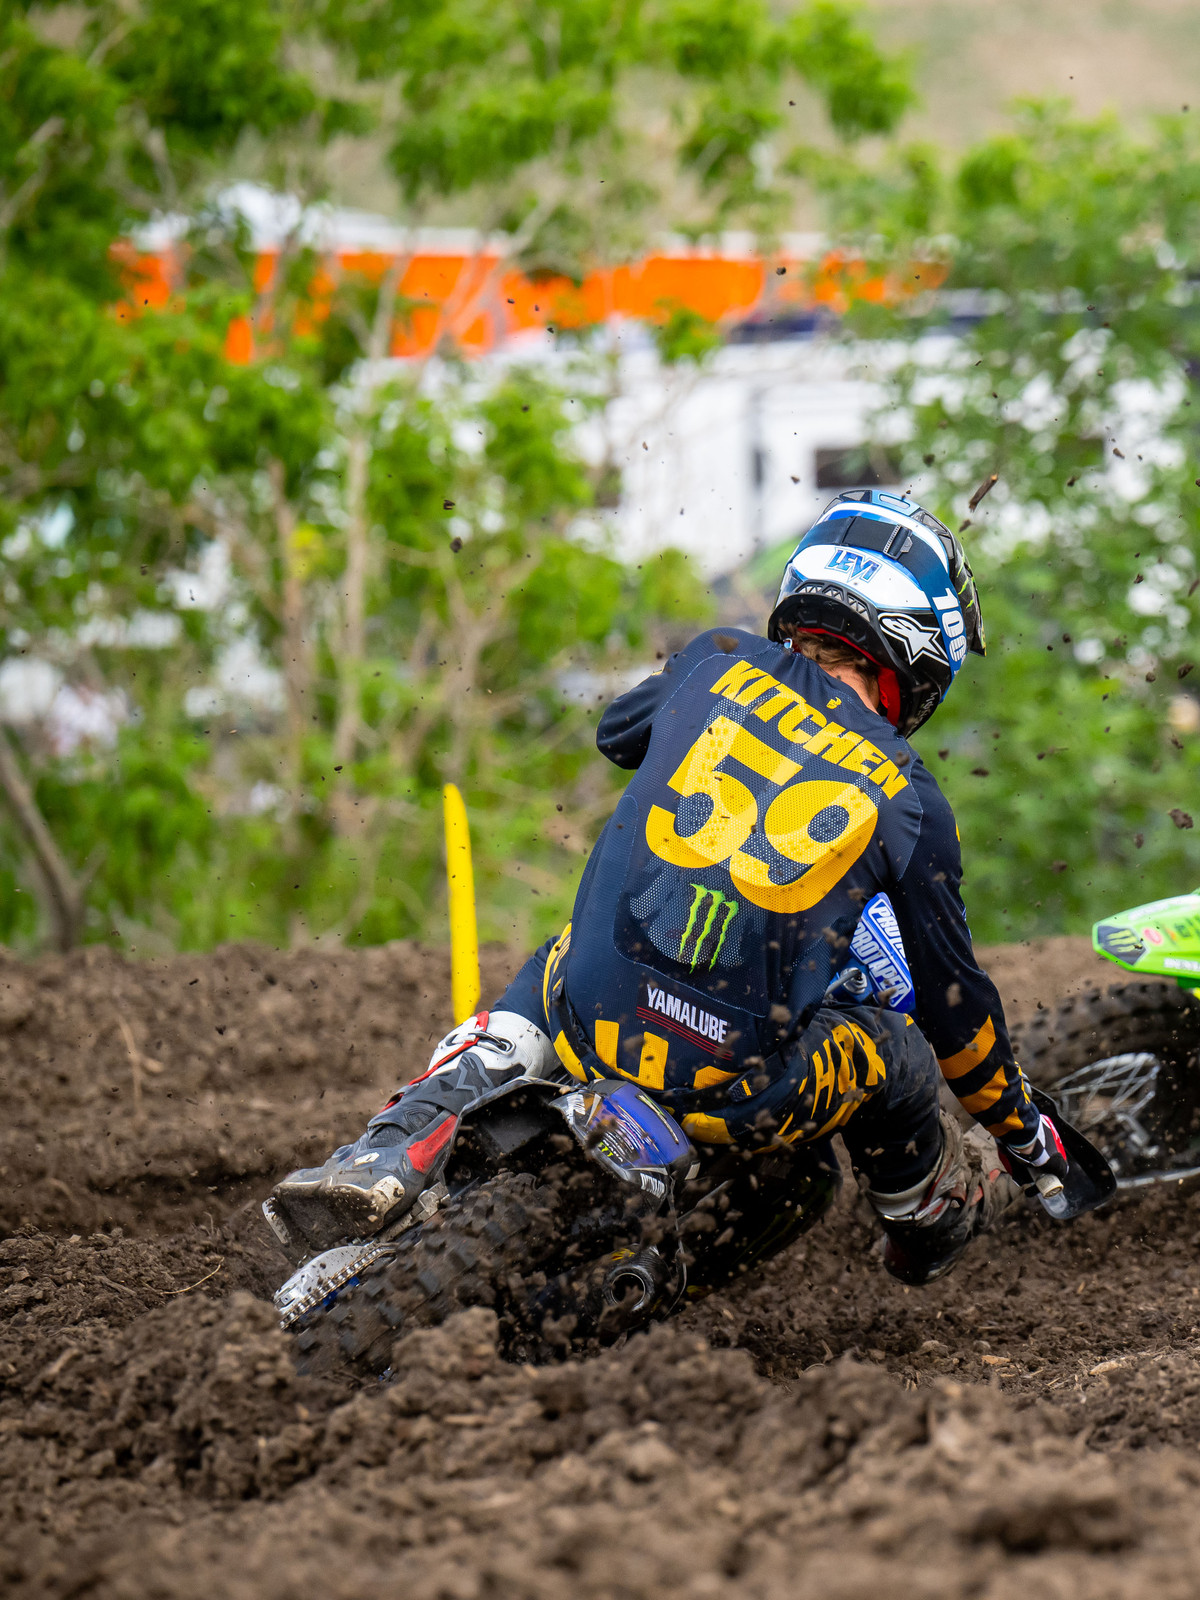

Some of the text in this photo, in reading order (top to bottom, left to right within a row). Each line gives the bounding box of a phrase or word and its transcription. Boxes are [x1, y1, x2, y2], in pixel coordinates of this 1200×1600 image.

[829, 550, 877, 581] LEVI
[931, 587, 966, 675] 100
[708, 659, 910, 800] KITCHEN
[645, 716, 879, 914] 59
[646, 984, 729, 1044] YAMALUBE
